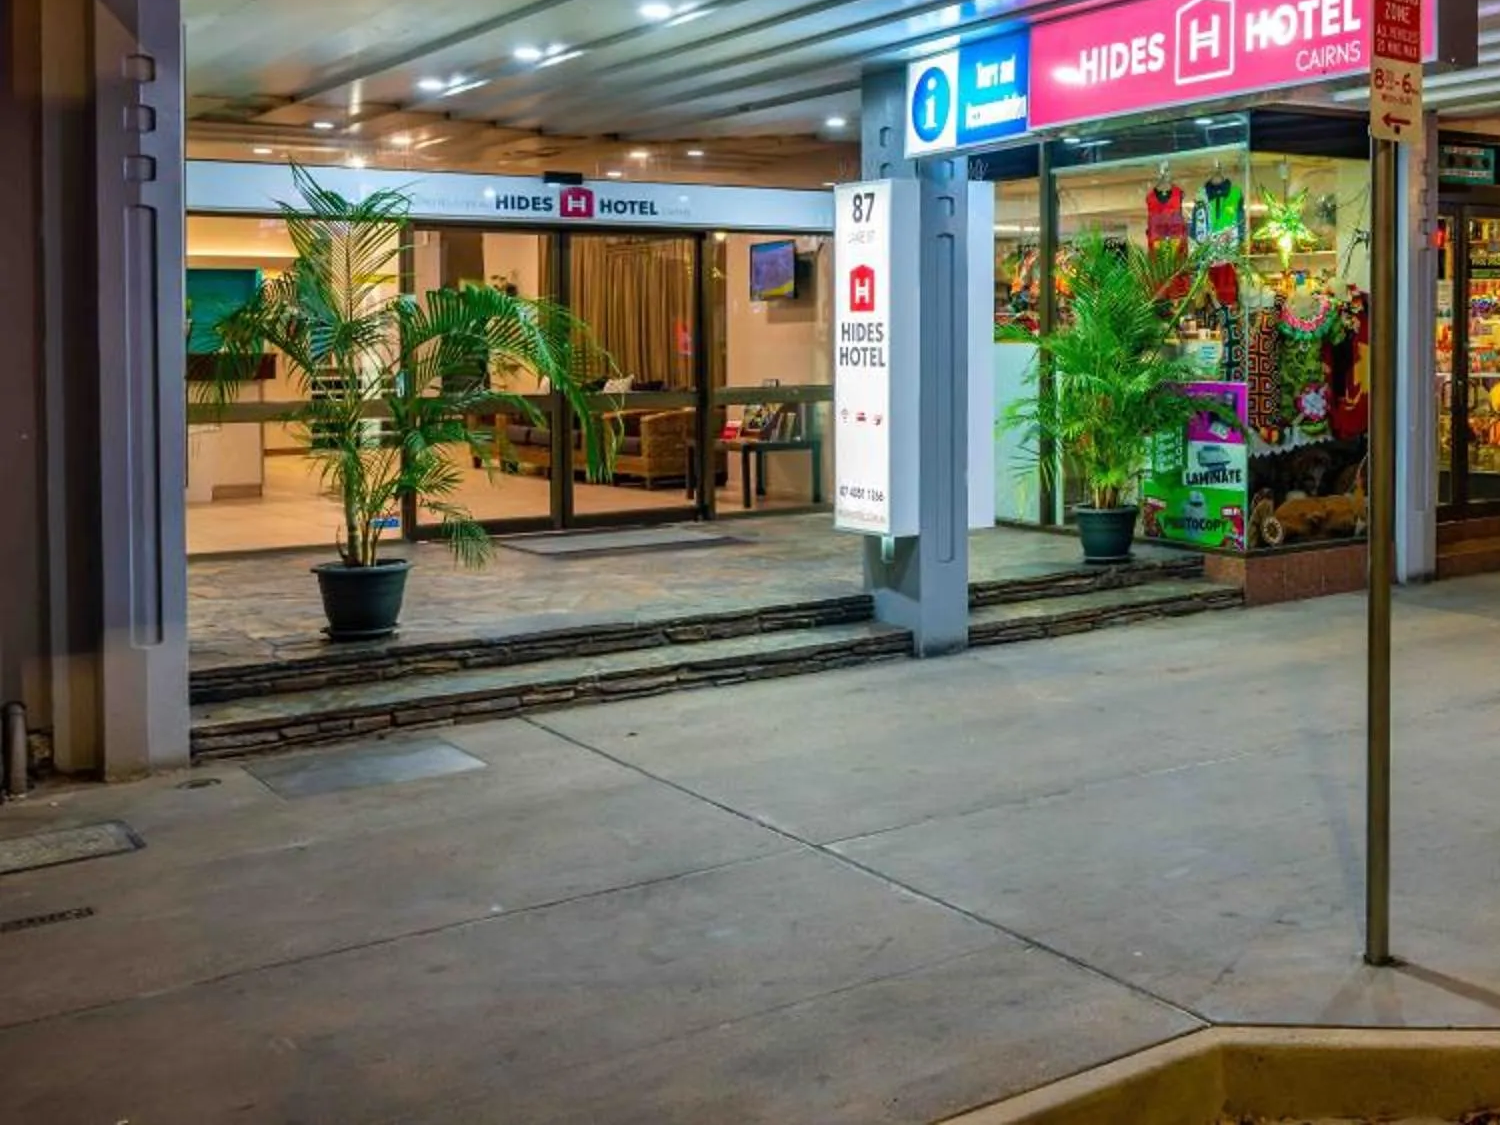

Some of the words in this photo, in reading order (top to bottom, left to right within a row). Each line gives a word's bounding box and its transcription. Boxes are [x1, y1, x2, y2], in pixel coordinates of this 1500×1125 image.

[1385, 3, 1411, 25] ZONE
[1079, 33, 1165, 85] HIDES
[1189, 14, 1220, 62] H
[1295, 40, 1361, 72] CAIRNS
[1375, 68, 1385, 89] 8
[496, 195, 553, 212] HIDES
[568, 197, 586, 213] H
[600, 199, 658, 216] HOTEL
[852, 192, 875, 223] 87
[855, 278, 869, 304] H
[841, 322, 884, 342] HIDES
[839, 346, 885, 367] HOTEL
[1185, 469, 1241, 486] LAMINATE
